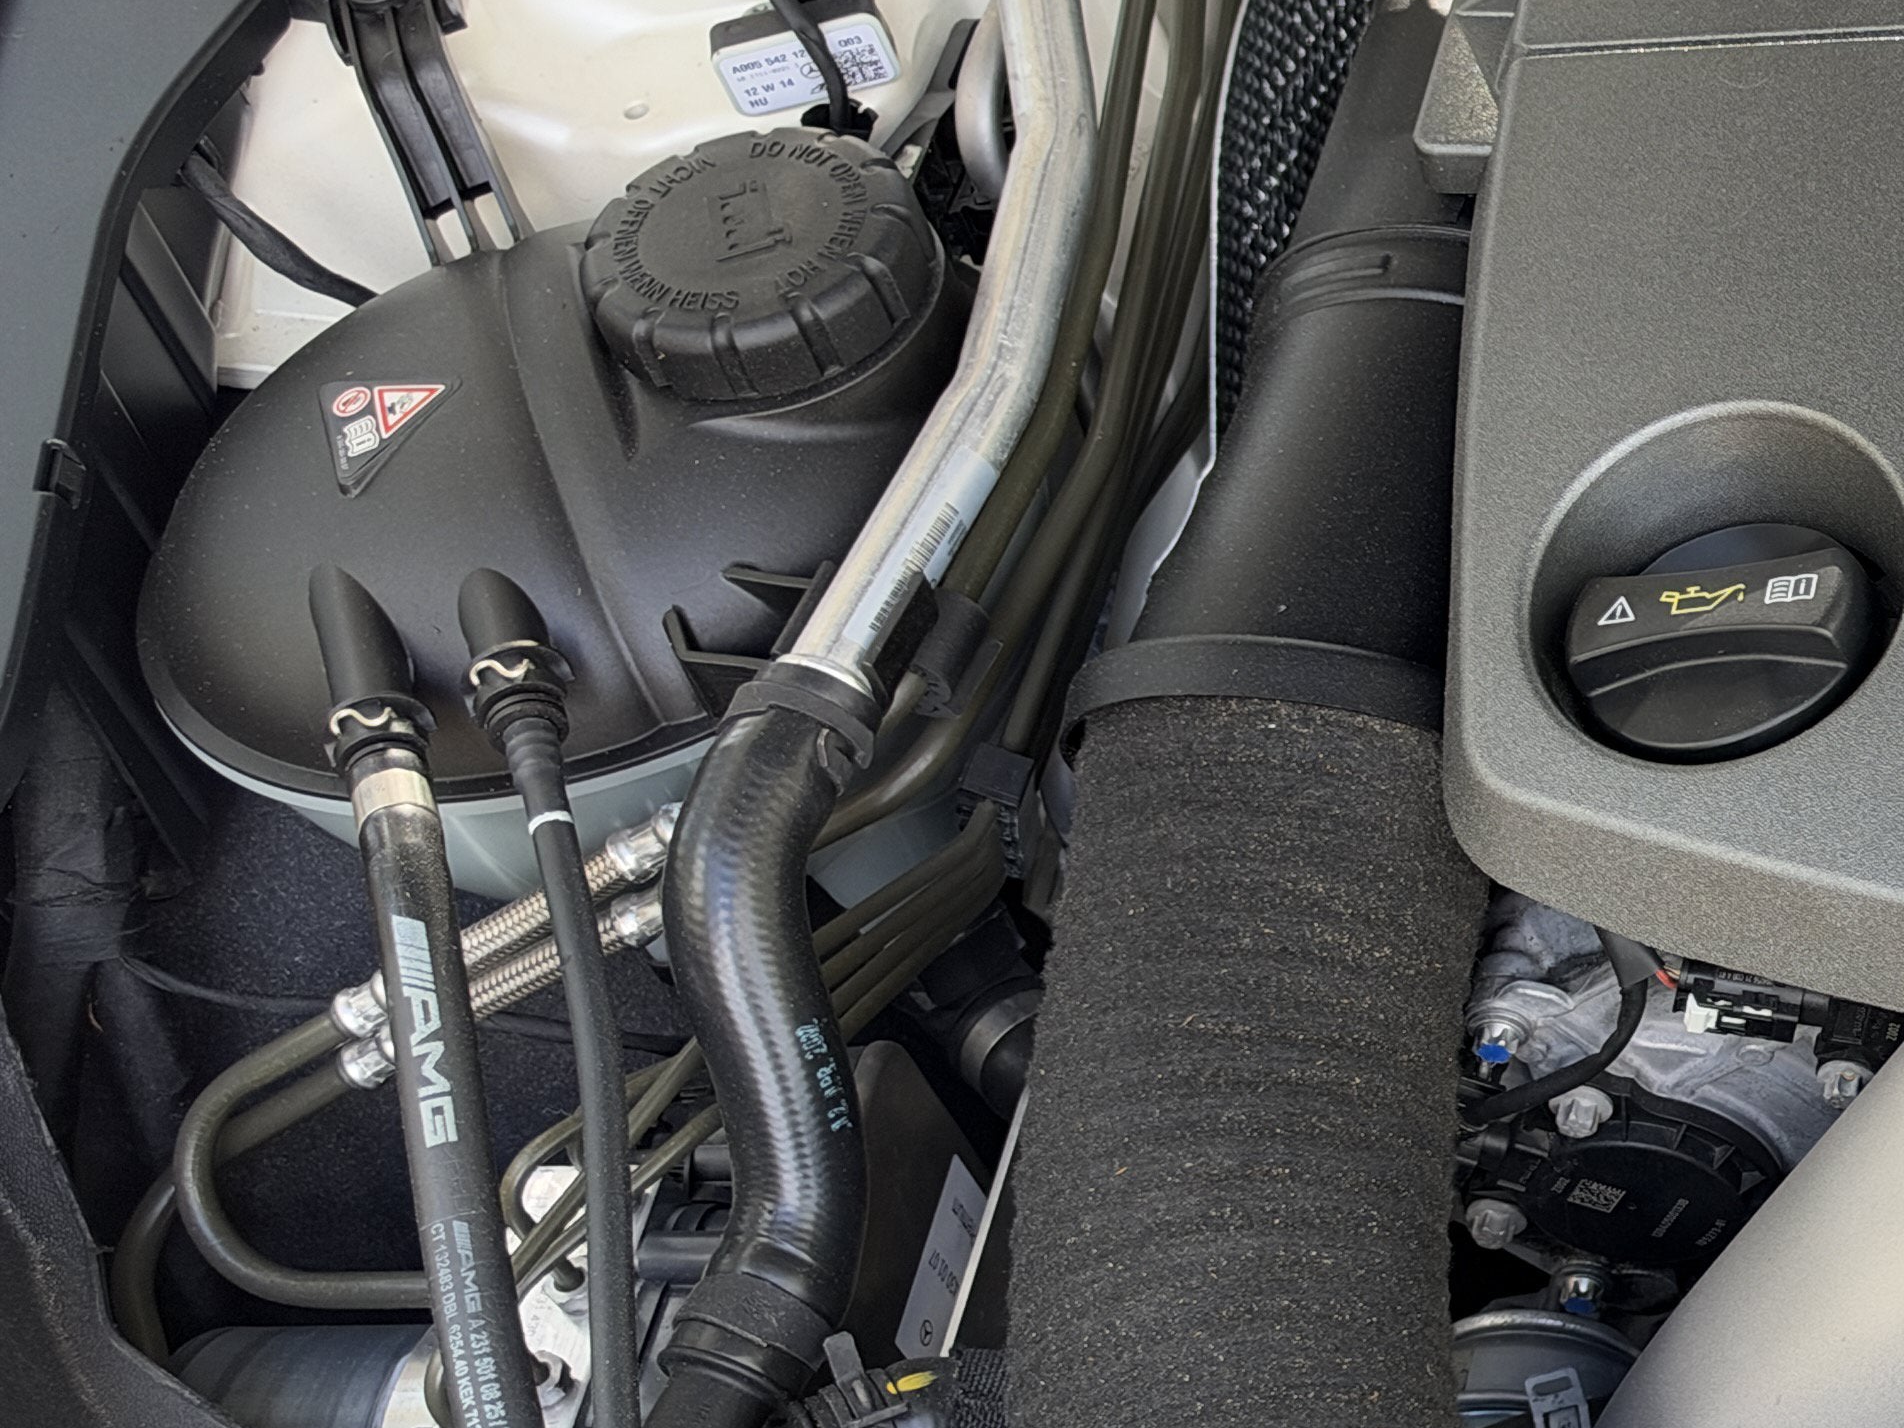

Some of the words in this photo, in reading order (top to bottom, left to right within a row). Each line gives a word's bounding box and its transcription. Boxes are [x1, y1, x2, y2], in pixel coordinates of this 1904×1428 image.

[761, 83, 776, 95] W
[779, 77, 796, 90] 14
[749, 140, 786, 159] DO
[788, 143, 839, 169] NOT
[647, 155, 718, 200] NICHT
[829, 160, 868, 207] OPEN
[817, 208, 868, 262] WHEN
[617, 259, 673, 304] WENN
[668, 289, 740, 311] HEISS
[402, 982, 459, 1149] AMG
